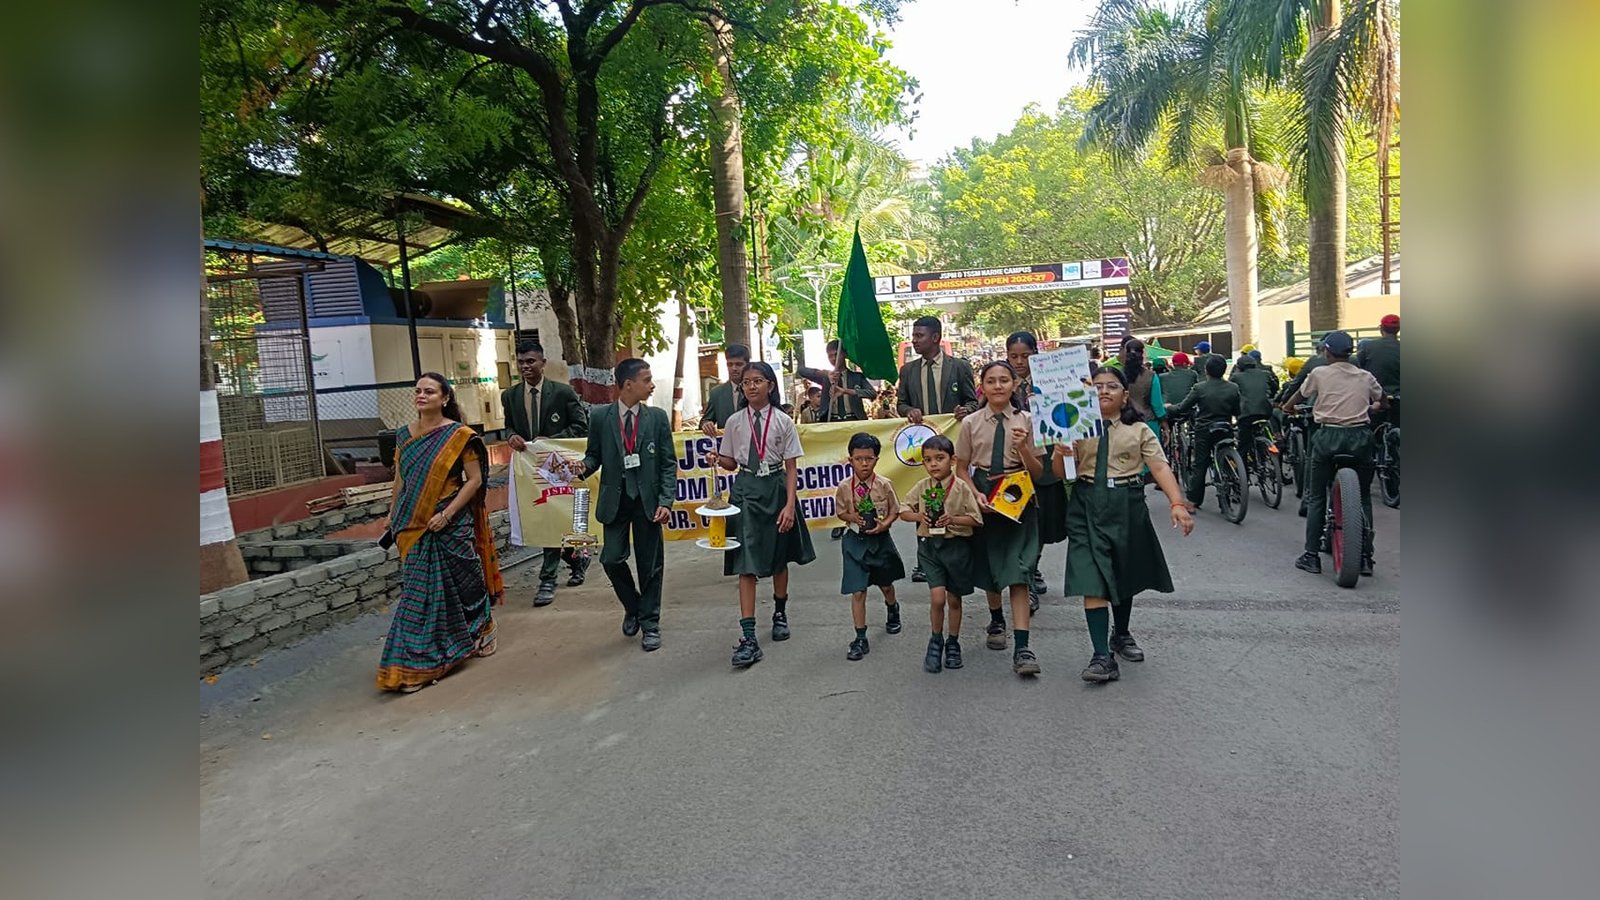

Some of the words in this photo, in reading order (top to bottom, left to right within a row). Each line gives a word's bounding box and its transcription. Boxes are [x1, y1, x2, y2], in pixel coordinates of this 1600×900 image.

[1003, 266, 1032, 275] CAMPUS
[926, 279, 983, 290] ADMISSIONS
[984, 276, 1009, 285] OPEN
[1010, 274, 1046, 283] 2026-27
[796, 463, 855, 490] SCHOO
[668, 510, 696, 529] JR.
[801, 496, 835, 518] EW)
